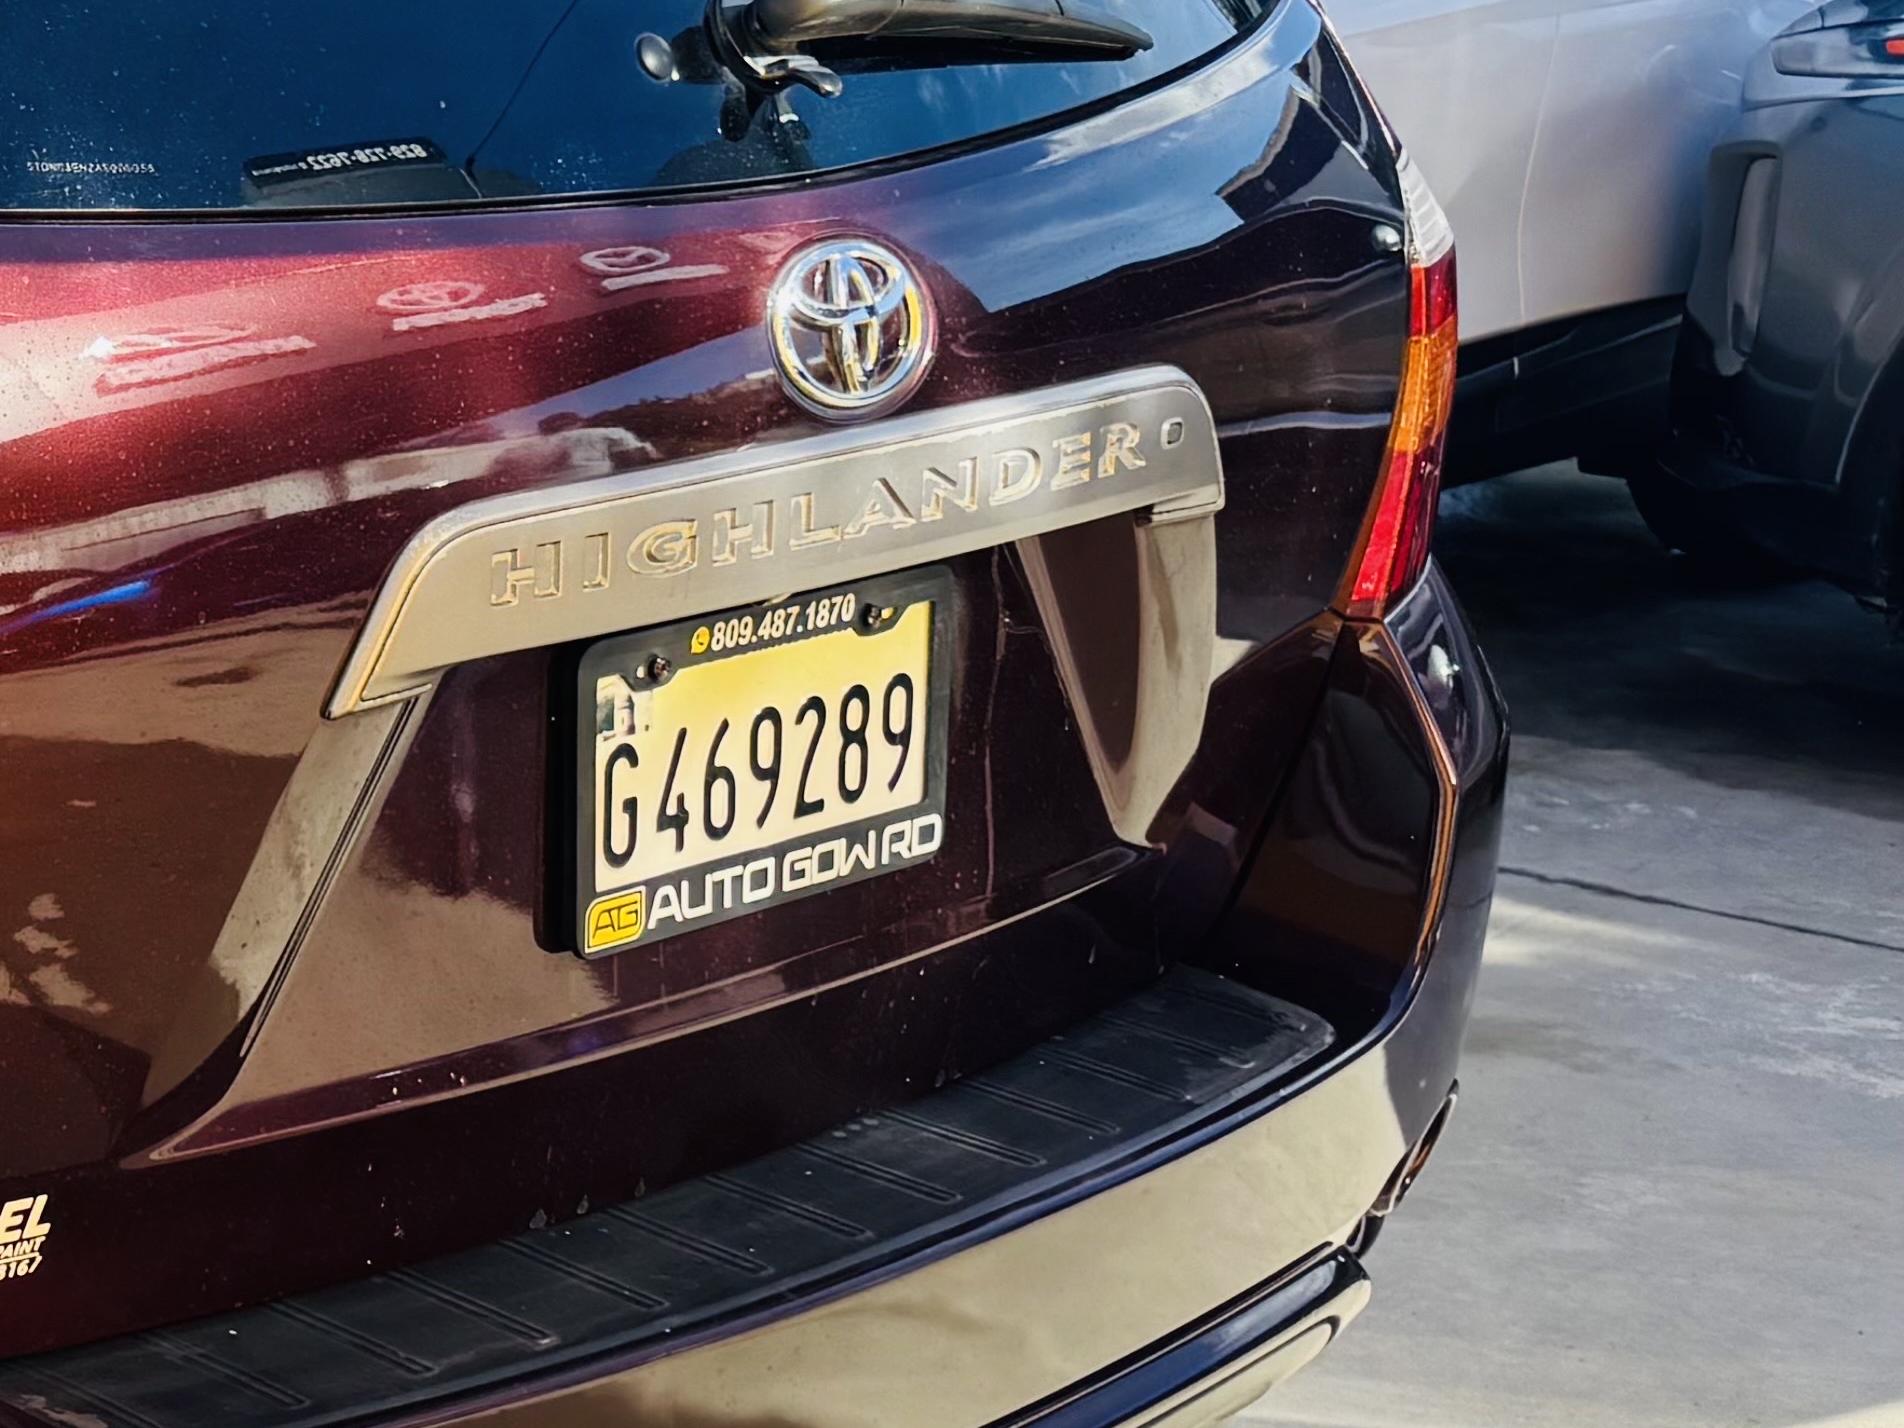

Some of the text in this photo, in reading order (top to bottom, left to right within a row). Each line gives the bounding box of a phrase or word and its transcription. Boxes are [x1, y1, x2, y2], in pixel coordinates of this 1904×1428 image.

[490, 420, 1147, 608] HIGHLANDER
[710, 592, 856, 652] 809.487.1870
[603, 672, 914, 869] G469289
[647, 856, 776, 930] AUTO
